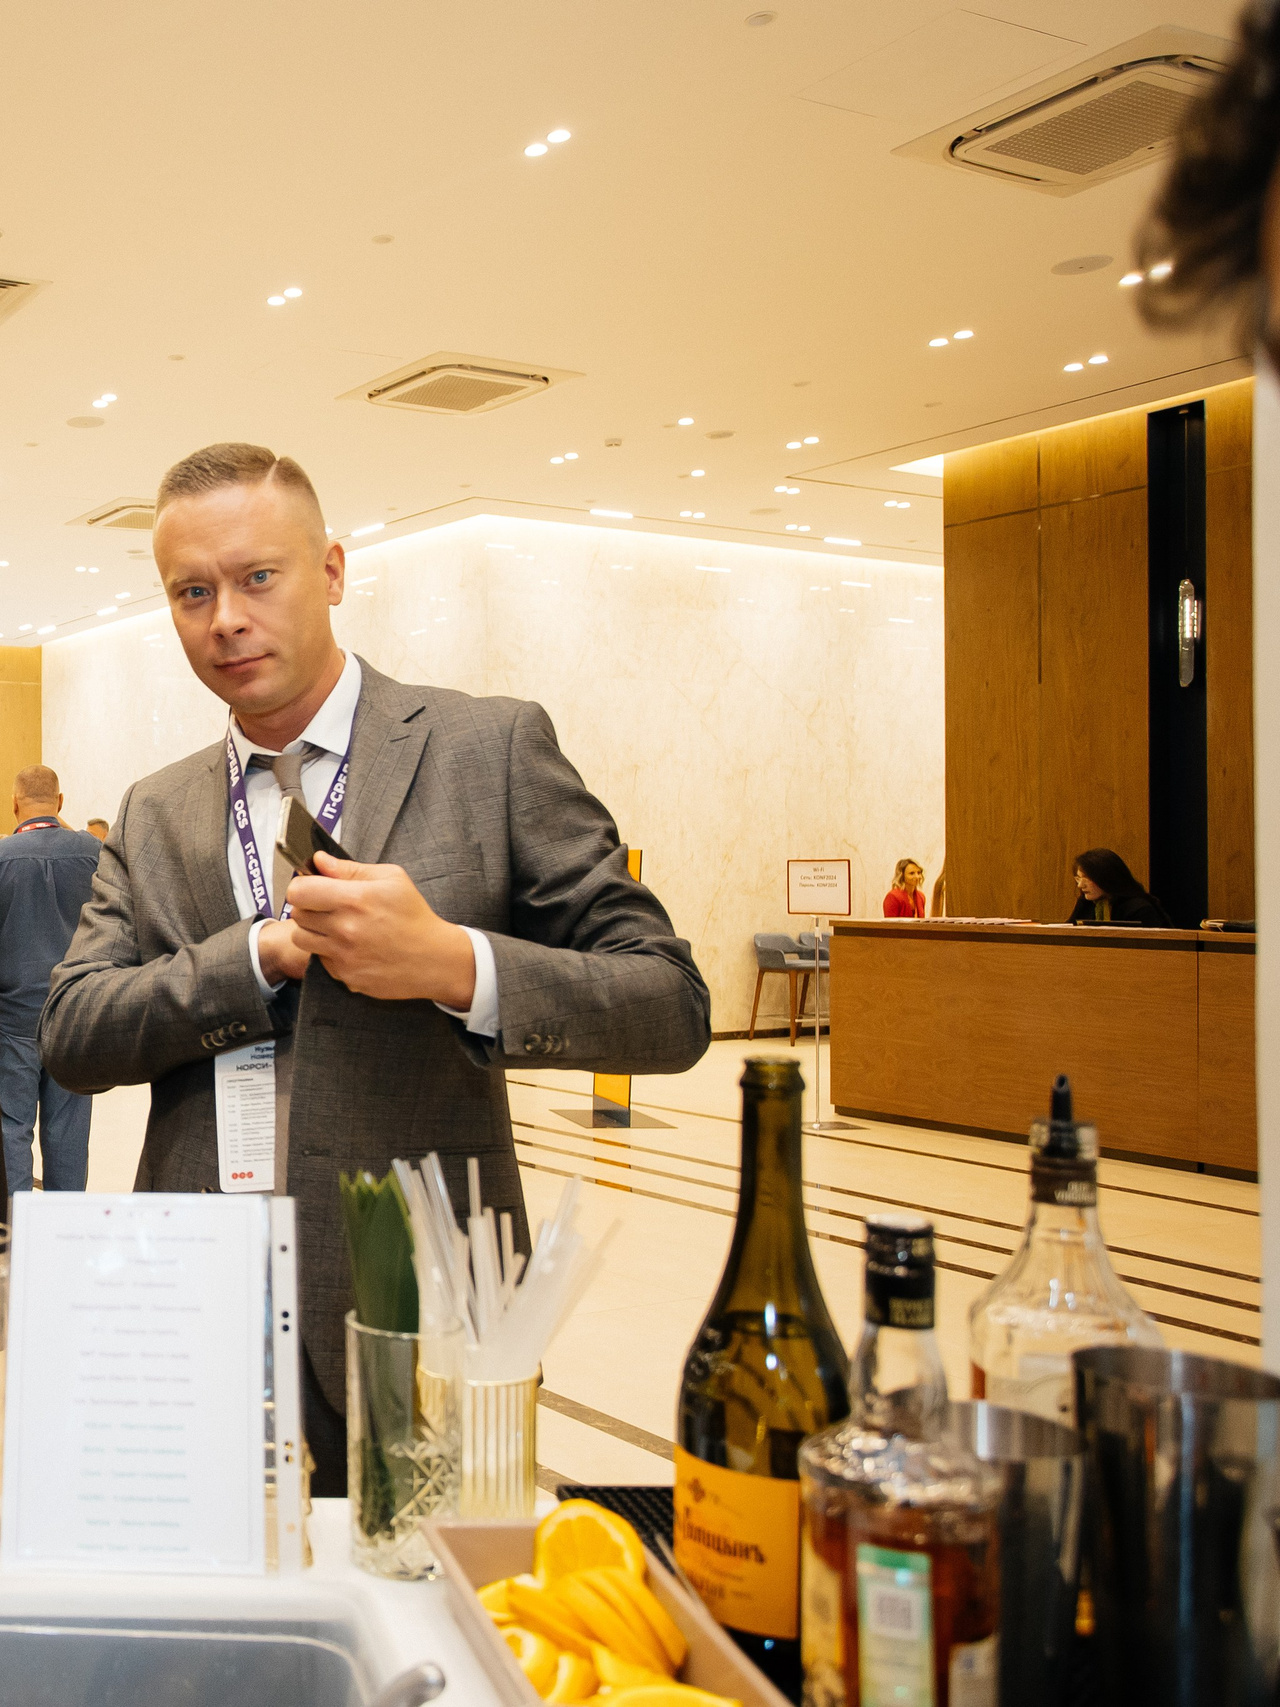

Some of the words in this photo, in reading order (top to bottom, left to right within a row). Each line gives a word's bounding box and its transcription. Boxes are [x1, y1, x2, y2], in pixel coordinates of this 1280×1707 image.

[233, 799, 249, 830] OCS
[244, 840, 267, 911] IT-СРЕДА
[236, 1062, 274, 1071] НОРСИ-
